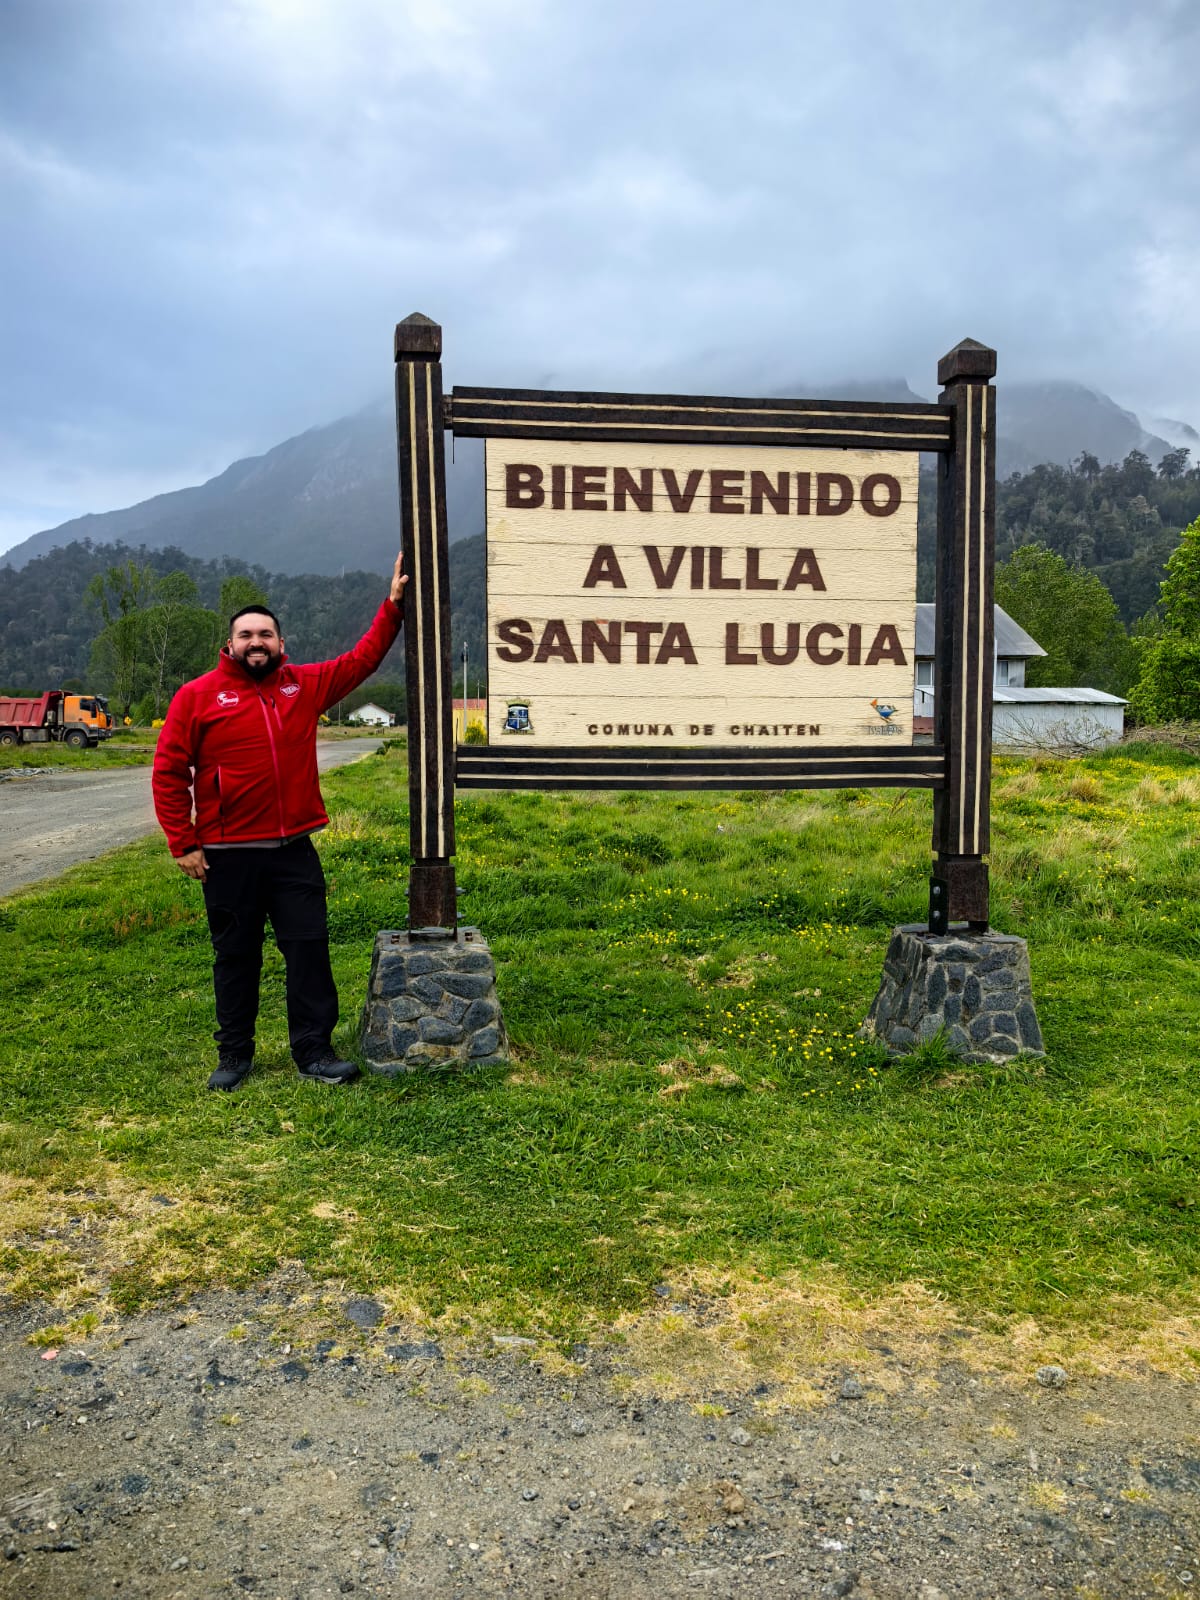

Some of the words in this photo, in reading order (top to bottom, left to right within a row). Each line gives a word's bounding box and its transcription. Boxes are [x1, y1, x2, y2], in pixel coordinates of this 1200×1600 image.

[504, 463, 903, 518] BIENVENIDO
[582, 544, 627, 589] A
[642, 545, 828, 592] VILLA
[495, 618, 699, 665] SANTA
[724, 622, 909, 667] LUCIA
[587, 723, 675, 737] COMUNA
[689, 723, 715, 737] DE
[729, 723, 822, 737] CHAITEN
